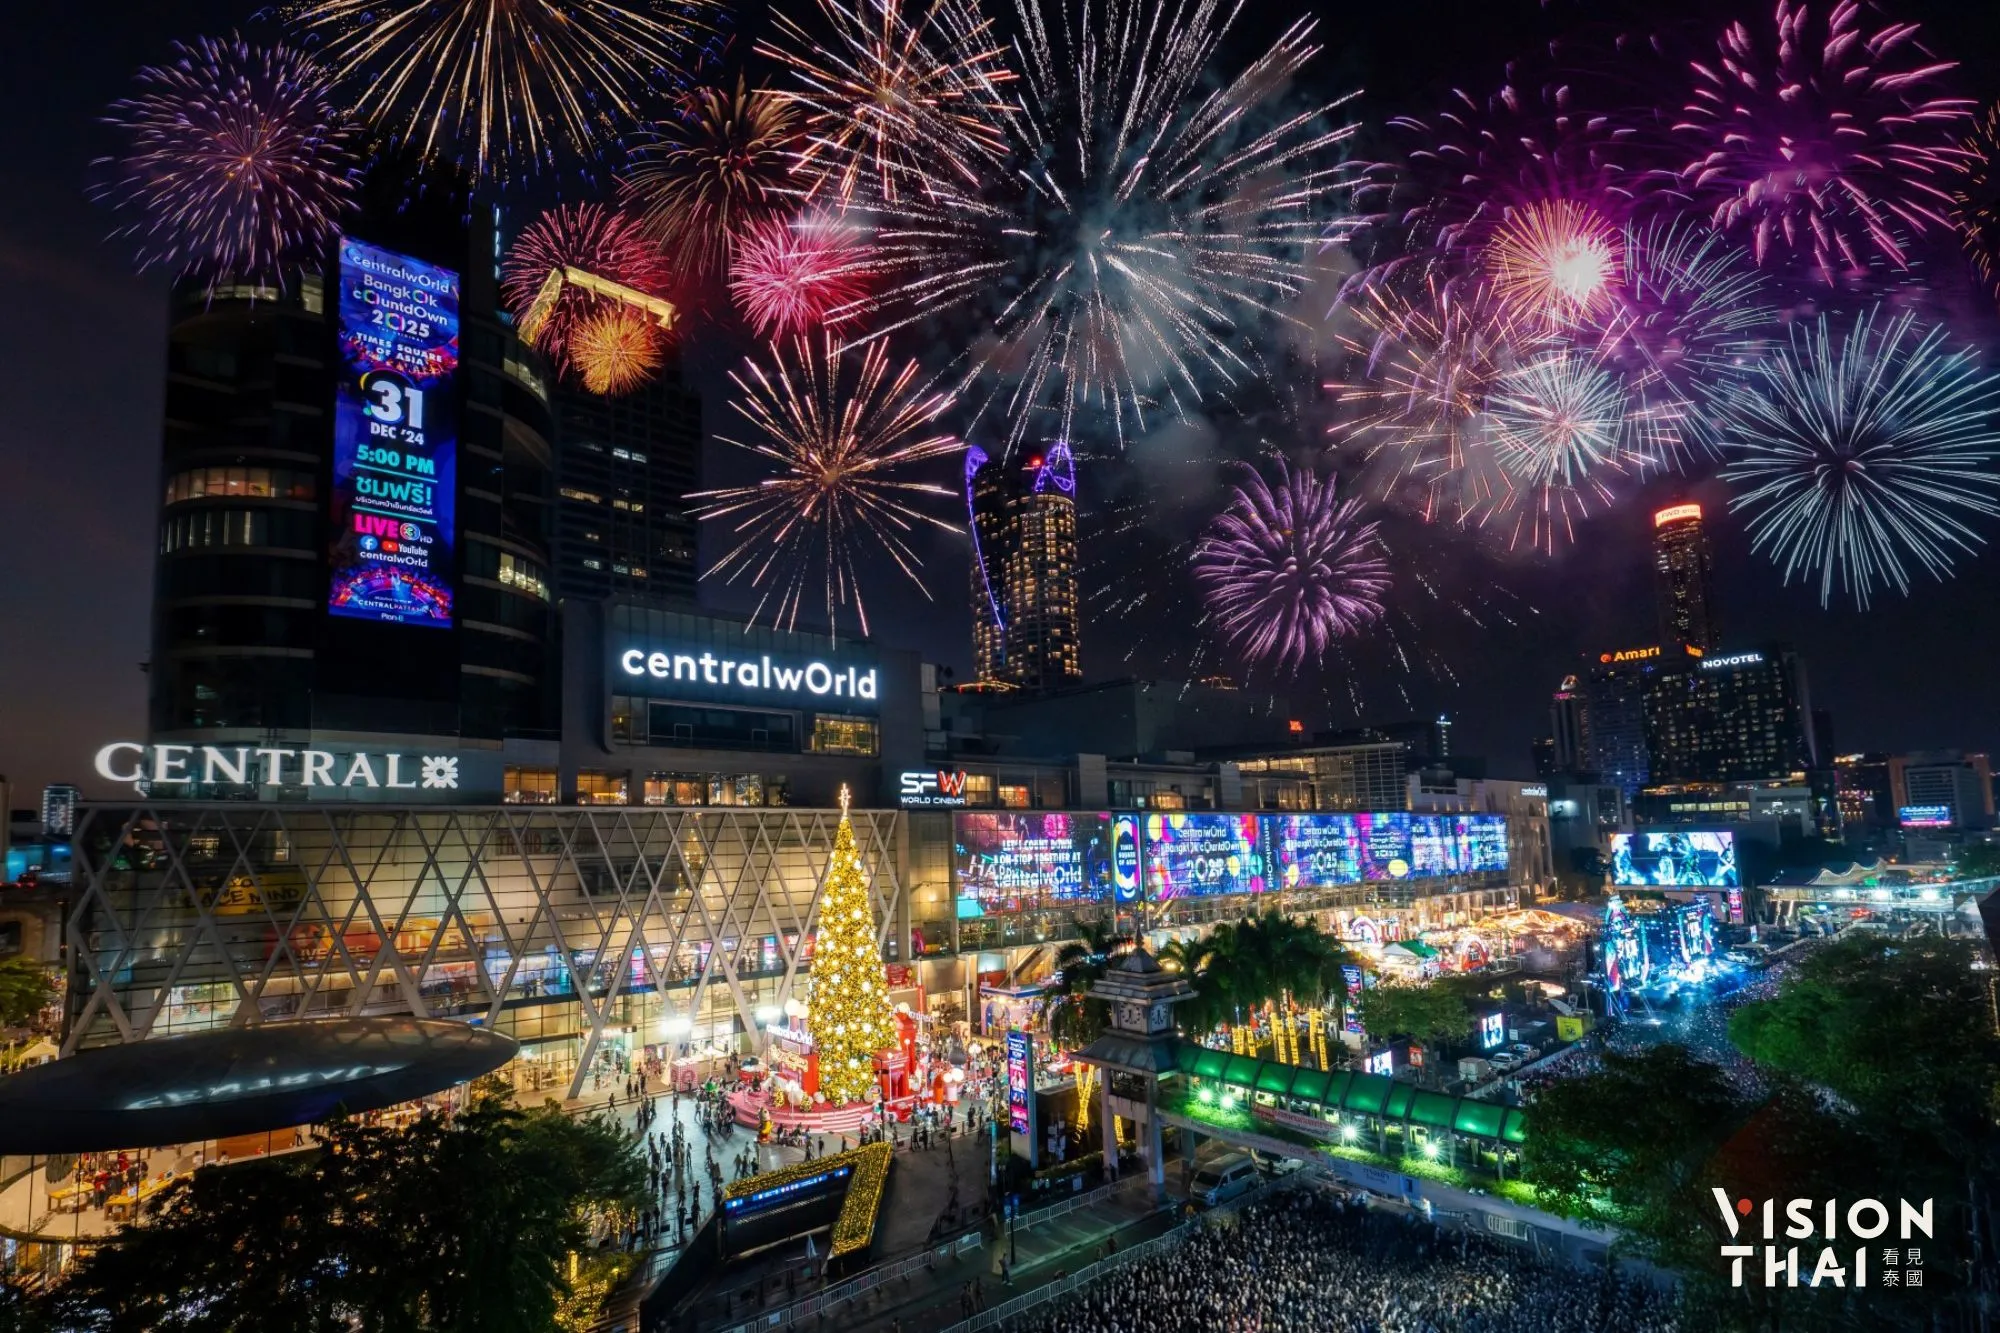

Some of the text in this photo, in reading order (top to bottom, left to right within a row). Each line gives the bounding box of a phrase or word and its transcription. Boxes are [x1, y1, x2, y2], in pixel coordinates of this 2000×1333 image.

[353, 255, 449, 293] centralwOrld
[353, 289, 448, 326] cOuntdOwn
[372, 310, 430, 338] 2025
[356, 332, 442, 362] TIMES SQUARE
[376, 347, 424, 366] OF ASIA
[371, 380, 423, 429] 31
[370, 422, 396, 439] DEC
[356, 444, 435, 475] 5:00 PM
[356, 476, 432, 506] ชมฟรี!
[354, 514, 398, 538] LIVE
[360, 551, 428, 567] centralwOrld
[399, 544, 428, 556] YouTube
[1614, 646, 1660, 661] Amari
[1702, 653, 1763, 668] NOVOTEL
[622, 649, 877, 699] centralwOrld
[95, 742, 416, 788] CENTRAL
[901, 796, 965, 805] WORLD CINEMA
